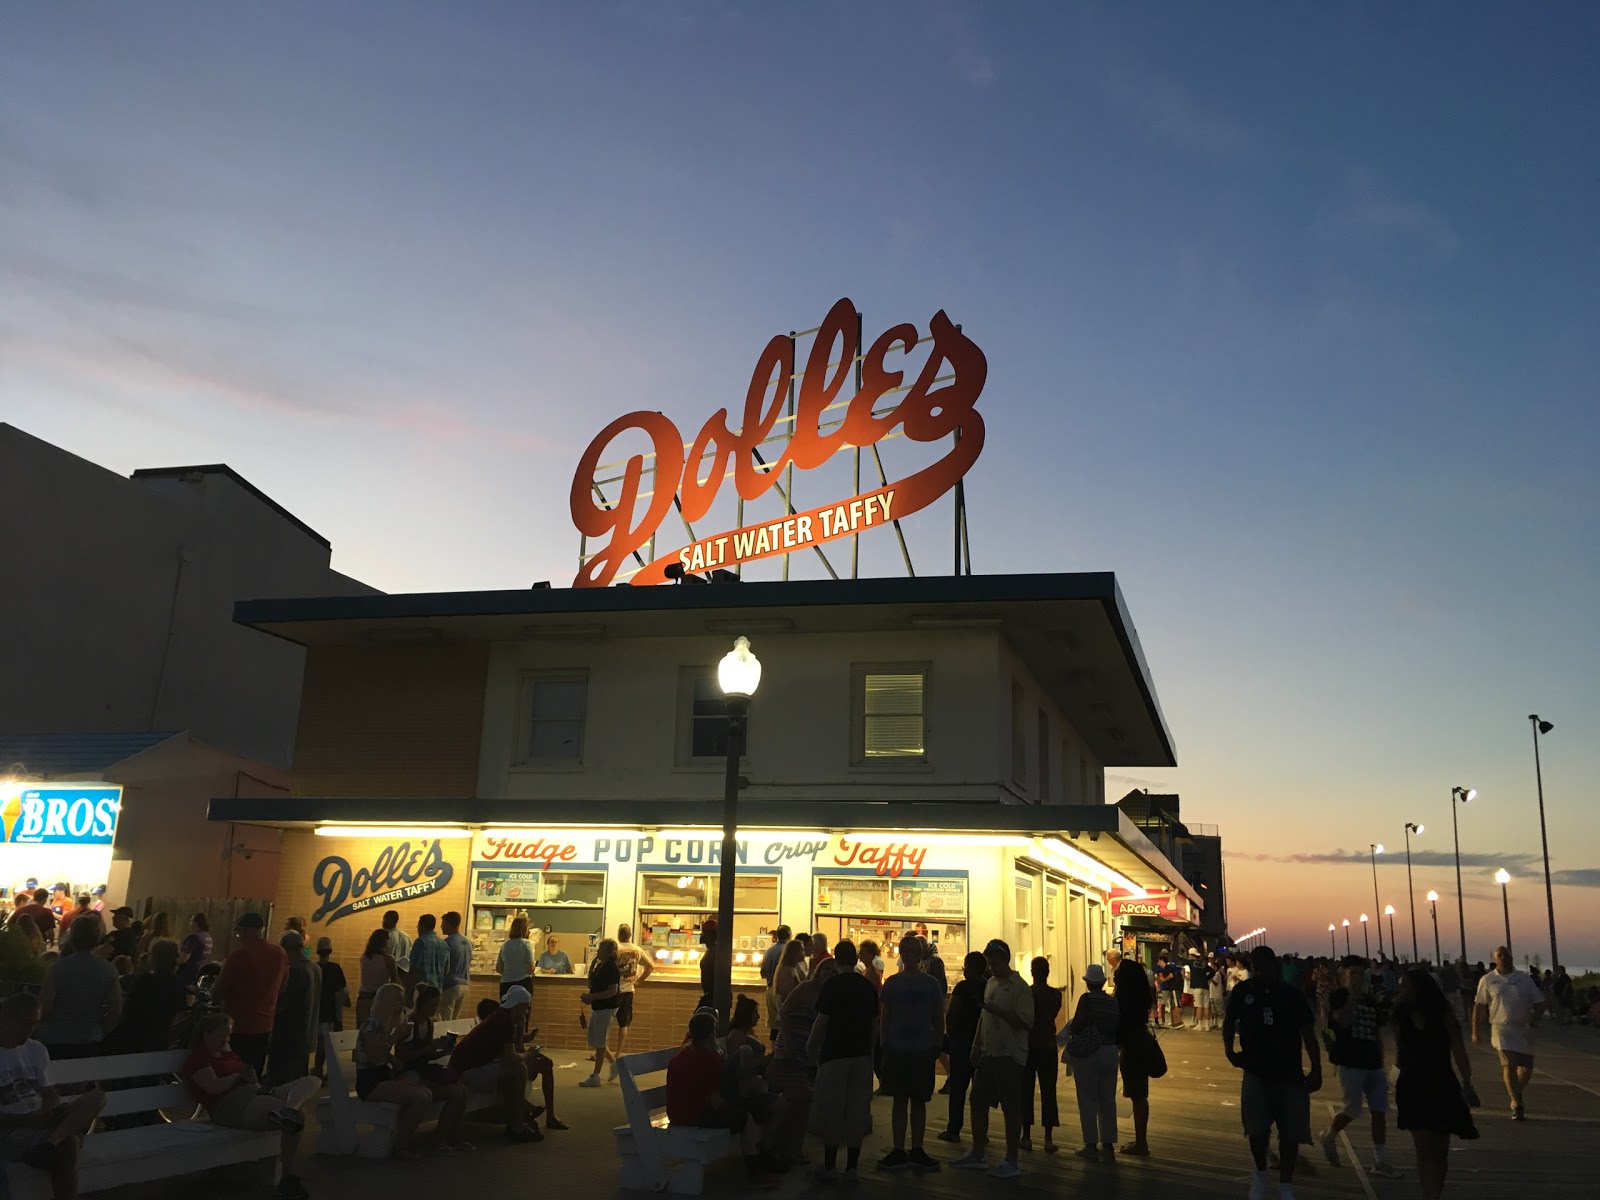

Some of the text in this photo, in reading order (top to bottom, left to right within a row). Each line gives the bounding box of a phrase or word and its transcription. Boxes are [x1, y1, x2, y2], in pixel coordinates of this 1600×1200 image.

[679, 489, 896, 573] SALT WATER TAFFY
[481, 837, 577, 870] Fudge
[594, 836, 654, 863] POP
[764, 839, 828, 865] Crisp
[833, 838, 928, 877] Taffy
[352, 879, 437, 911] SALT WATER TAFFY
[1119, 902, 1161, 915] ARCADE
